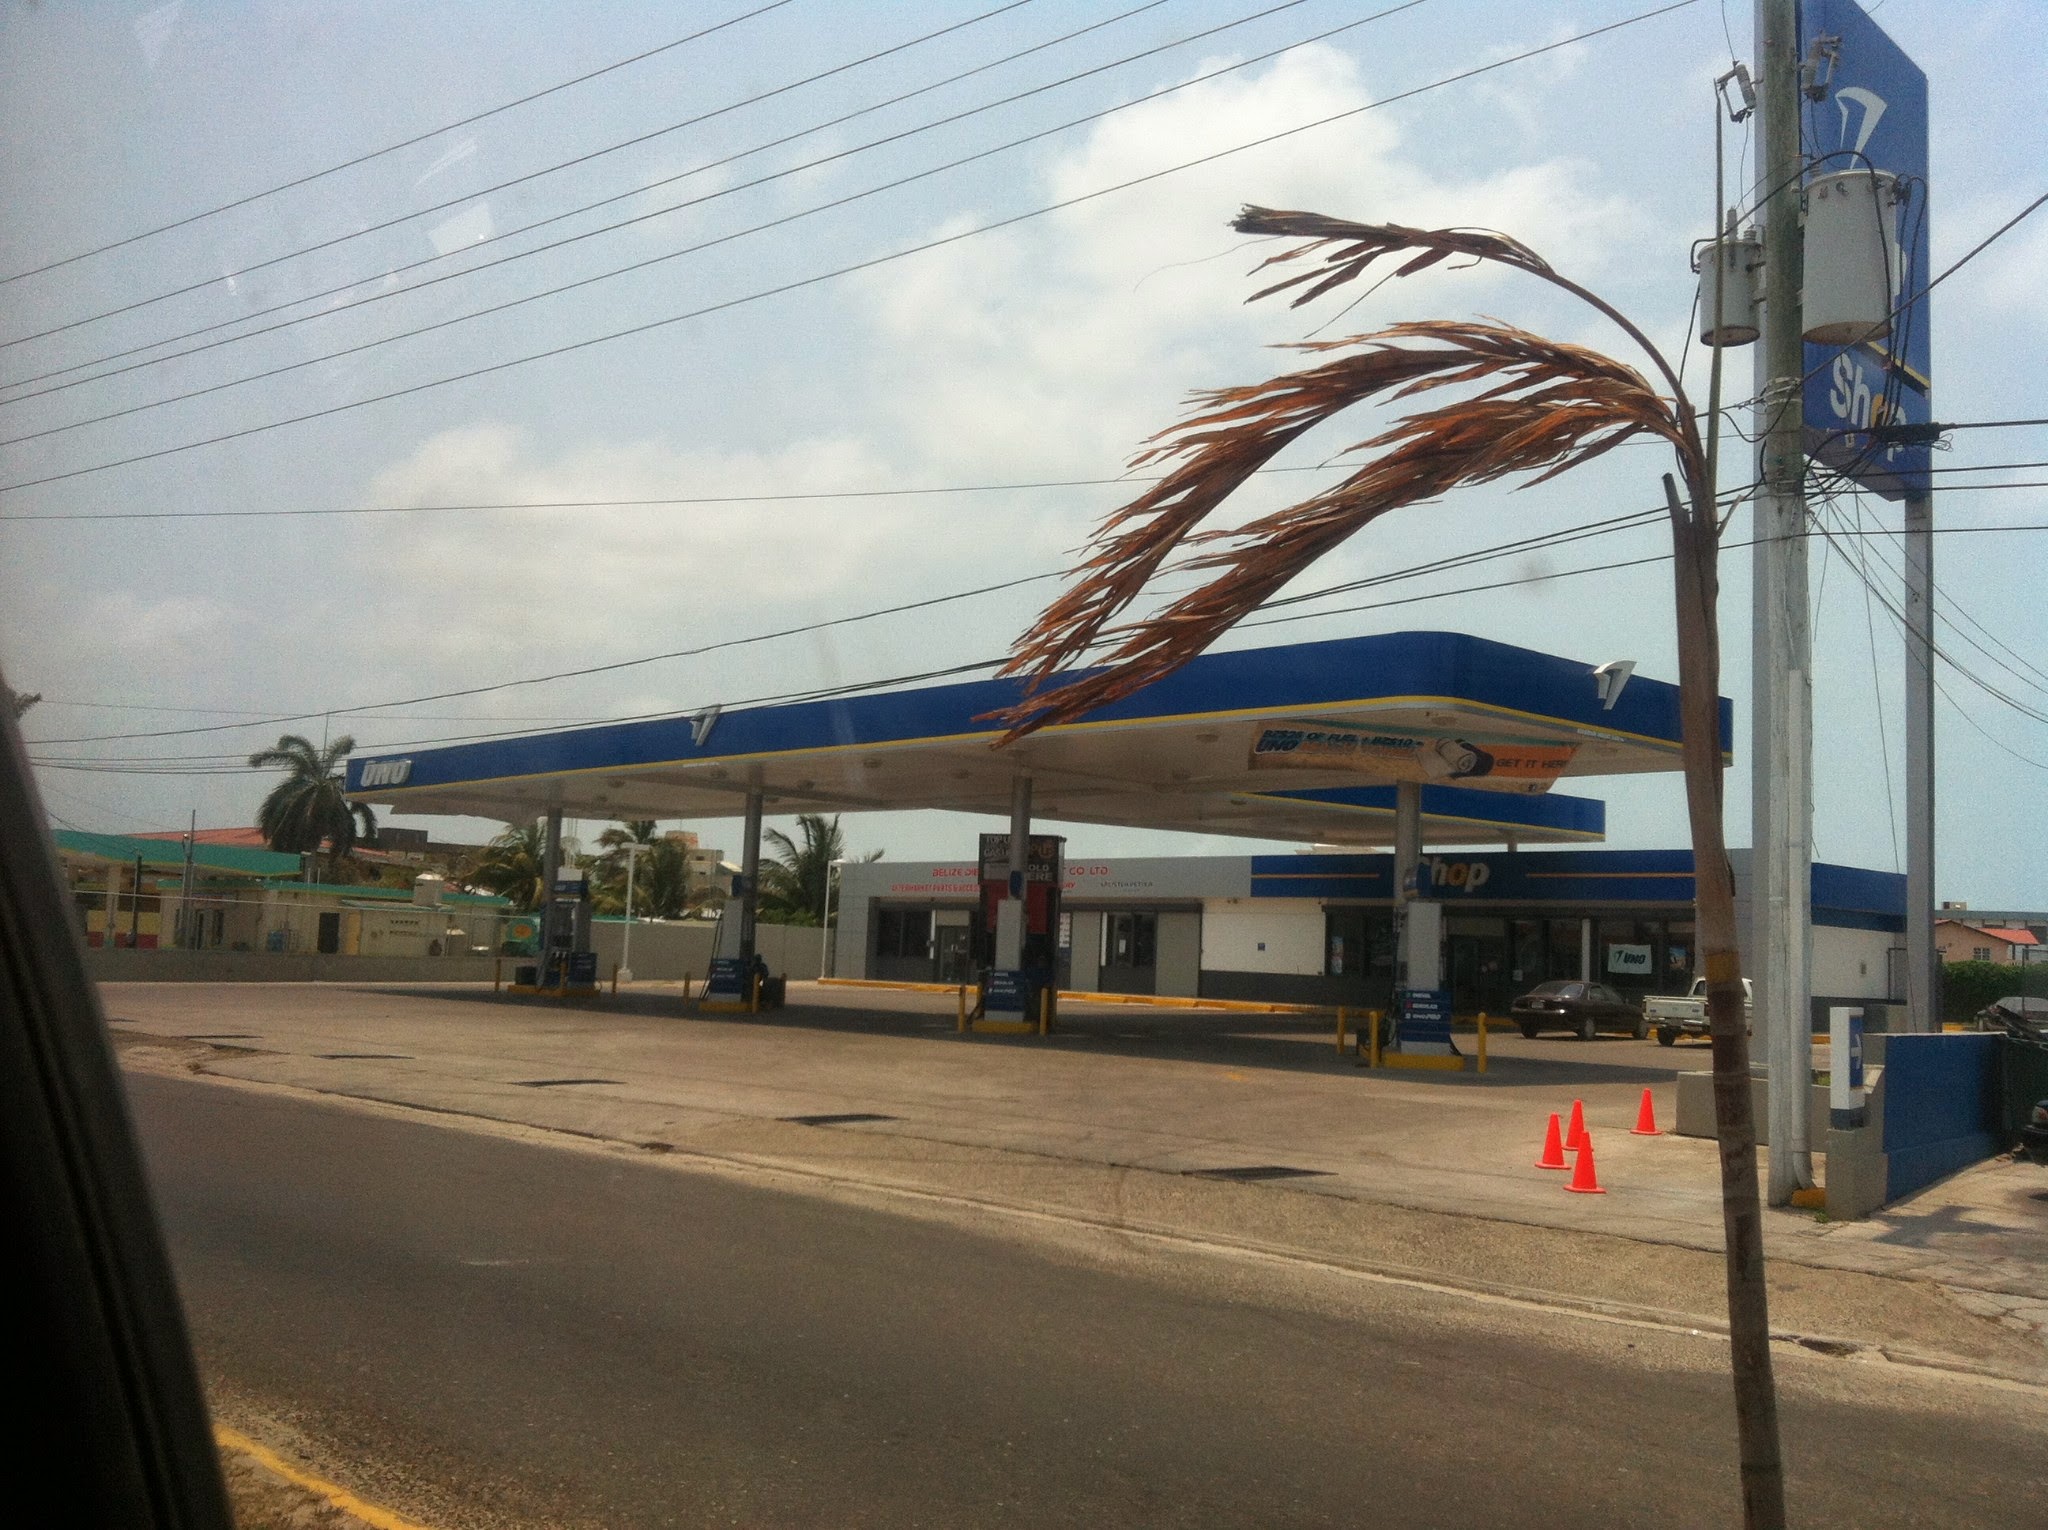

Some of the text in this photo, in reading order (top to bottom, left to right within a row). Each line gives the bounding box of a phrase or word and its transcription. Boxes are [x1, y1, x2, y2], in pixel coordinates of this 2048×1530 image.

[1496, 758, 1521, 768] GET
[1525, 759, 1538, 768] IT
[361, 760, 411, 787] UNO
[932, 868, 963, 877] BELIZE
[1069, 866, 1108, 876] CO LTD
[1623, 952, 1646, 965] UNO
